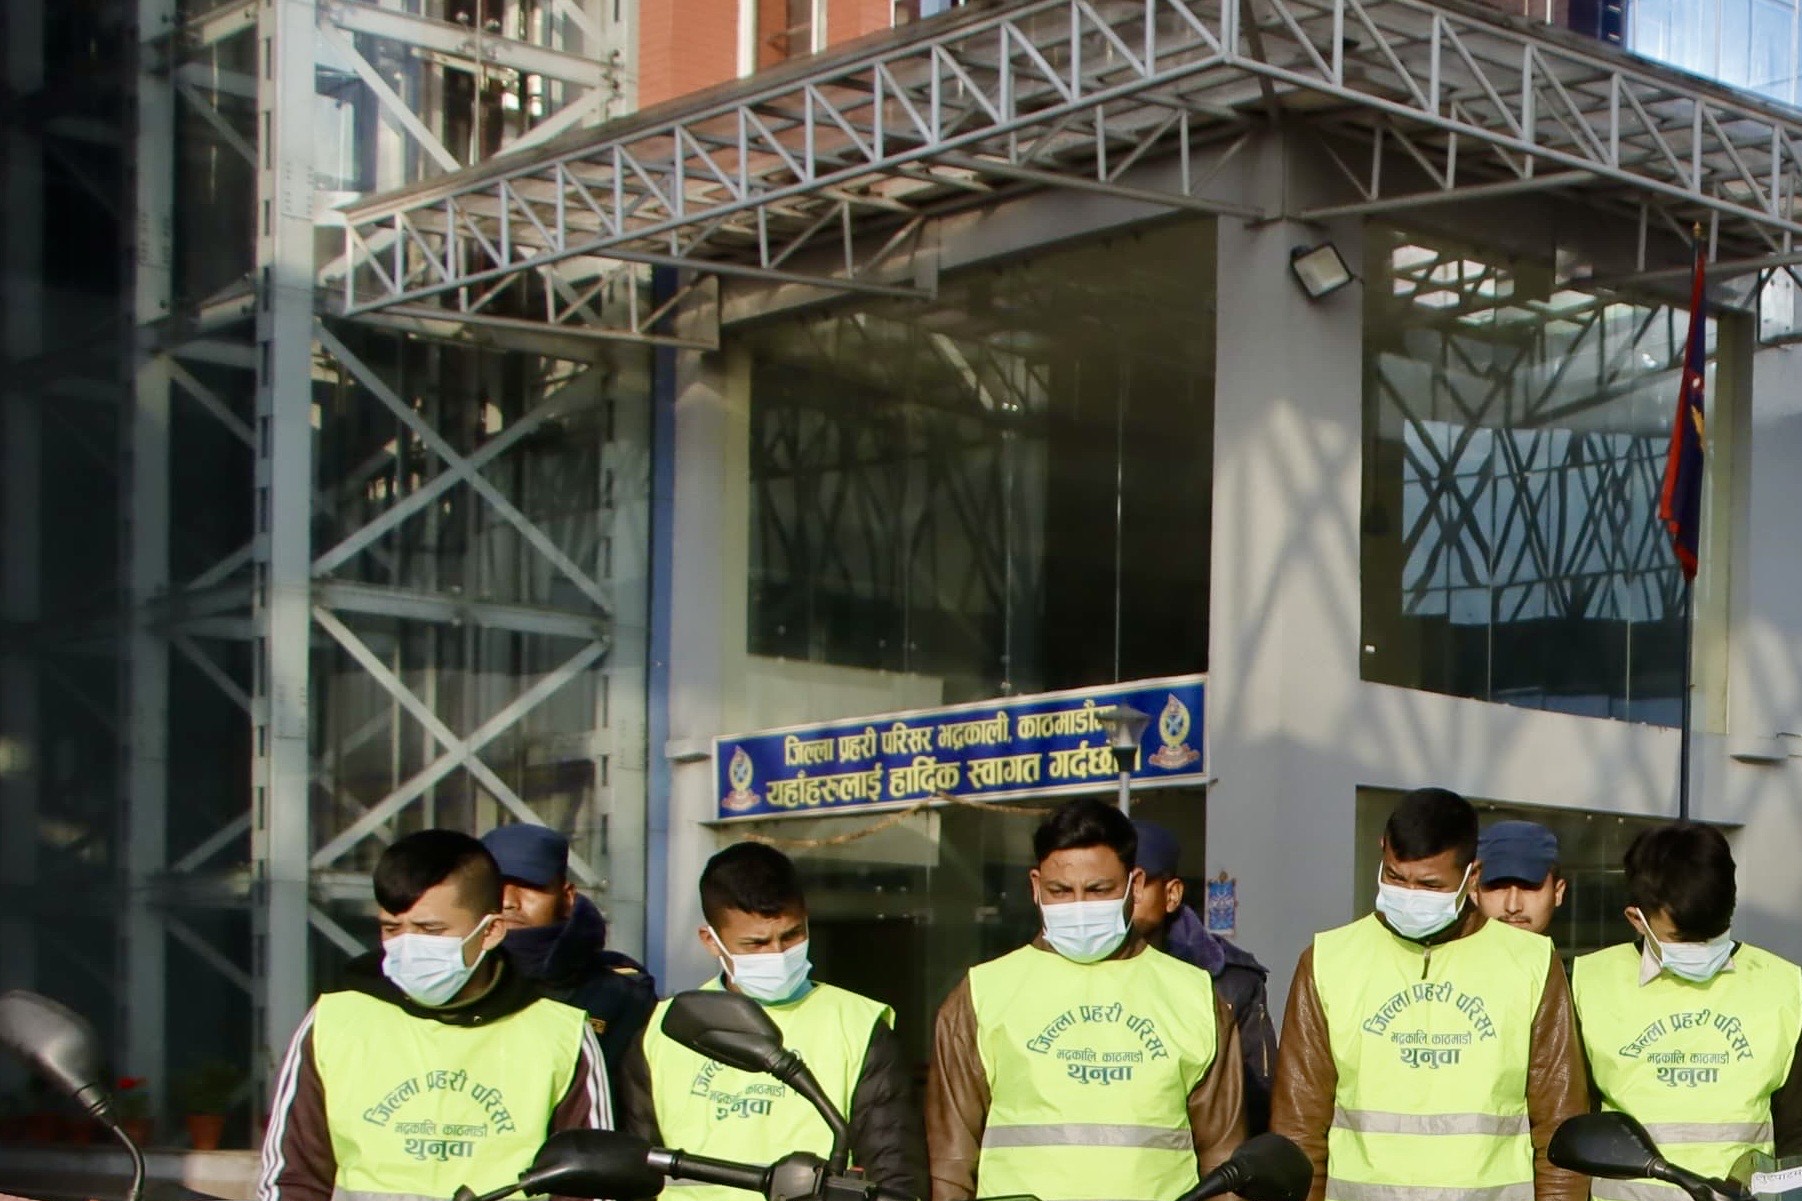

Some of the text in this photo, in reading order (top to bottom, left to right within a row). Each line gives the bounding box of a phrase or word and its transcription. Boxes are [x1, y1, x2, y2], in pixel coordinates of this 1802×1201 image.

[784, 735, 834, 767] जिल्ला
[838, 727, 877, 764] प्रहरी
[881, 721, 933, 758] परिसर
[966, 750, 1043, 788] स्वागत
[1027, 1002, 1169, 1061] जिल्ला प्रहरी परिसर
[1363, 981, 1497, 1042] जिल्ला प्रहरी परिसर
[1618, 1008, 1754, 1062] जिल्ला प्रहरी परिसर
[1067, 1062, 1134, 1086] थुनुवा
[1400, 1047, 1462, 1070] थुनुवा
[1656, 1066, 1720, 1088] थुनुवा
[363, 1069, 516, 1136] जिल्ला प्रहरी परिसर
[405, 1137, 475, 1162] थुनुवा
